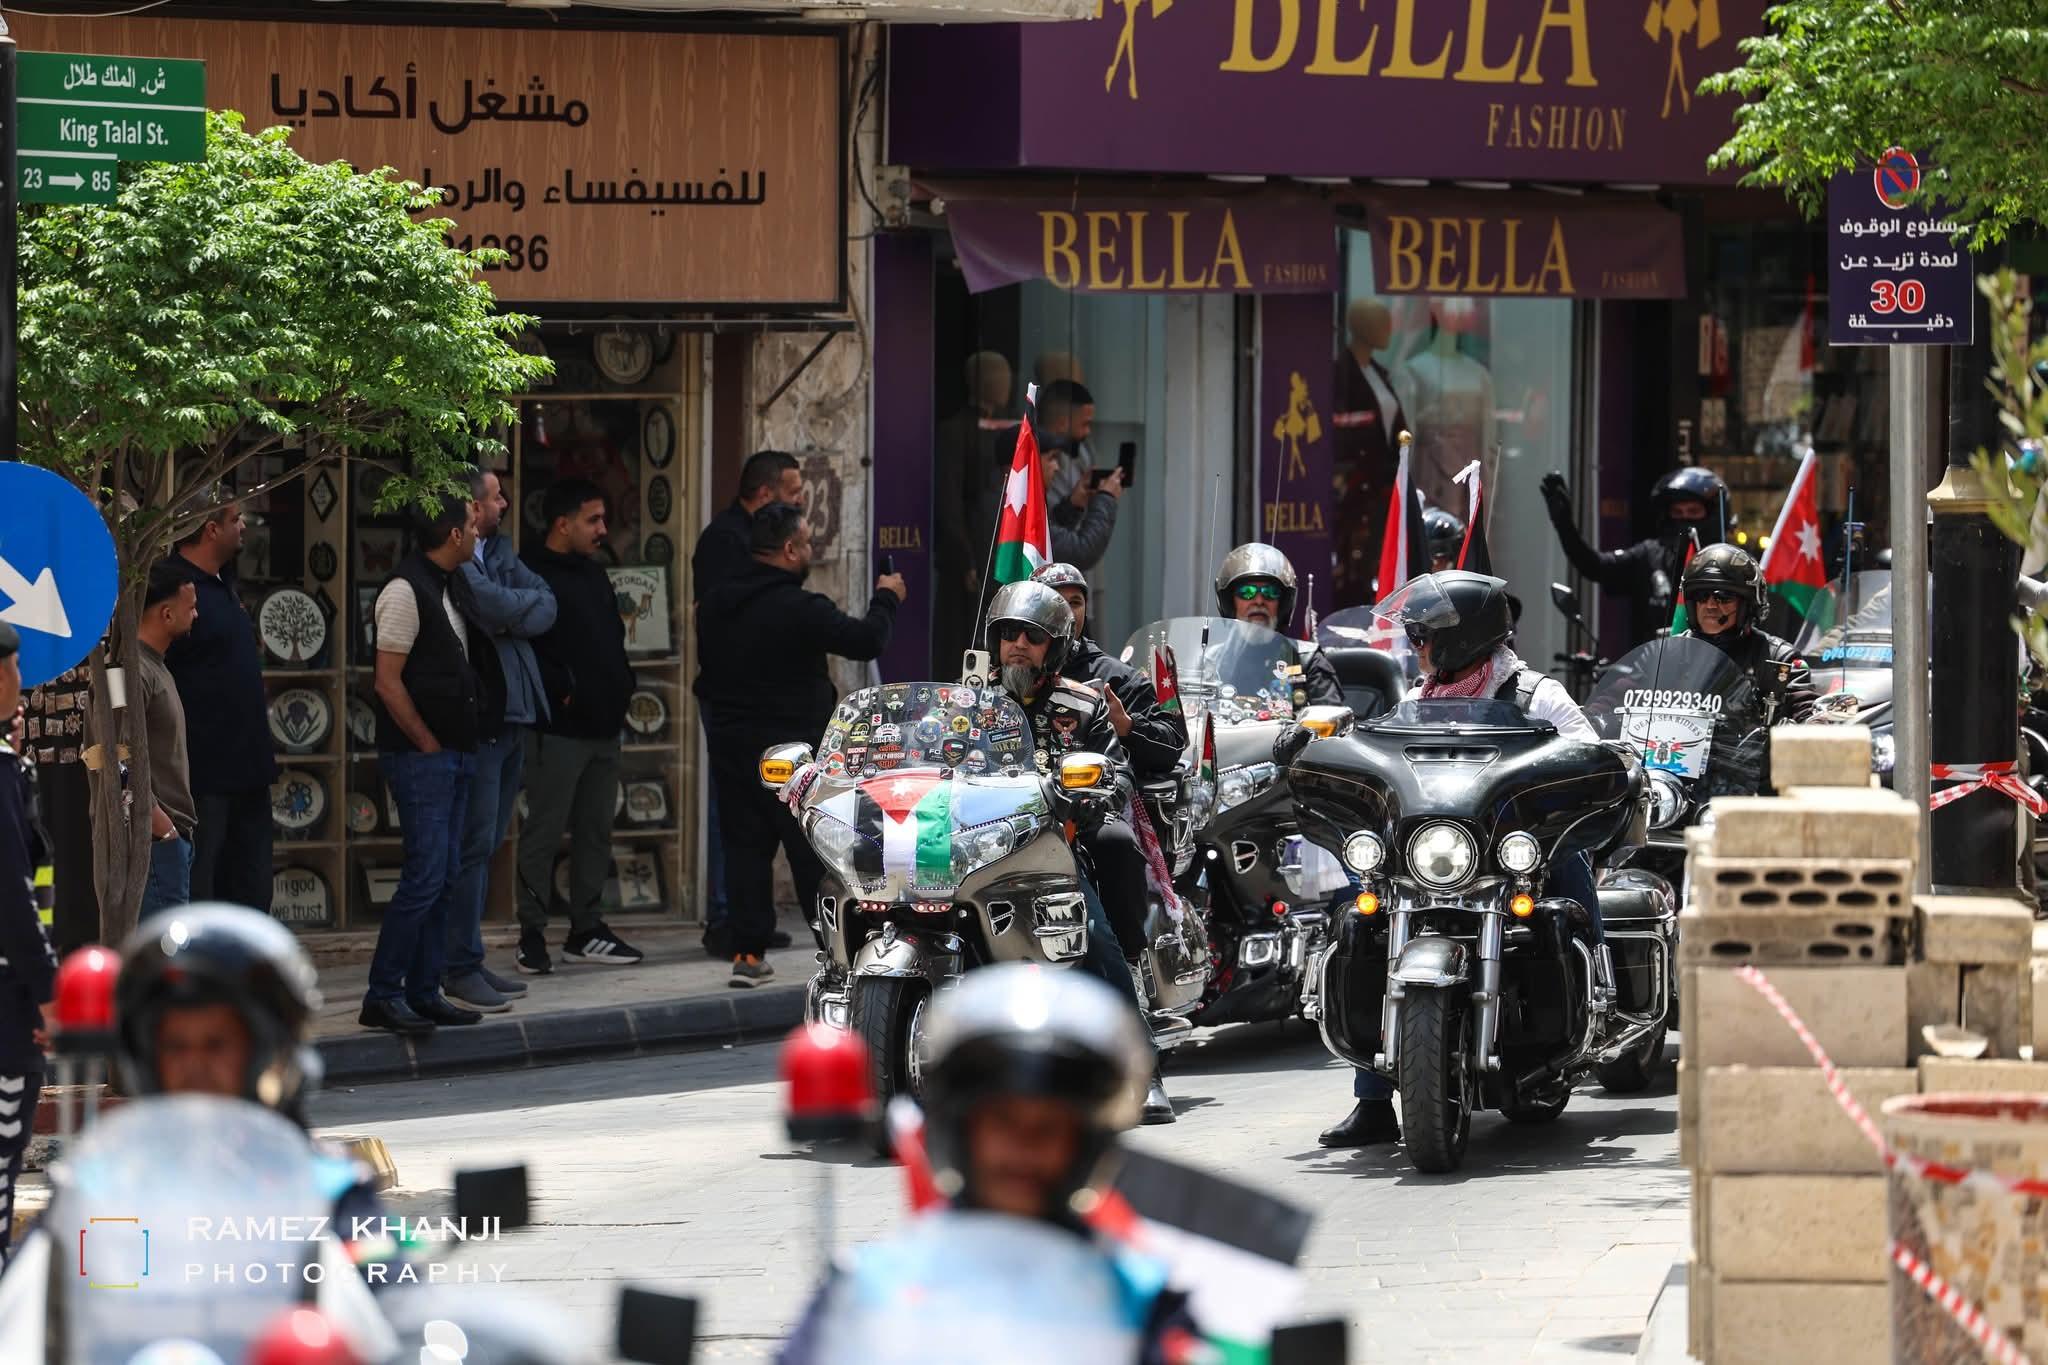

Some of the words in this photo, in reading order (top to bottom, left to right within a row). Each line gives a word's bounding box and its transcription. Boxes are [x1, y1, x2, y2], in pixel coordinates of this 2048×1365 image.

[63, 62, 97, 90] طلال
[101, 63, 136, 89] الملك
[140, 66, 166, 96] ش.
[271, 61, 417, 127] أكاديا
[429, 75, 589, 135] مشغل
[60, 117, 98, 148] King
[102, 119, 142, 145] Talal
[146, 122, 169, 146] St.
[1486, 103, 1626, 150] FASHION
[23, 167, 43, 189] 23
[91, 170, 111, 192] 85
[544, 166, 767, 216] للفسيفساء
[1839, 217, 1900, 238] الوقوف
[1037, 208, 1253, 290] BELLA
[1263, 263, 1327, 285] FASHION
[1386, 215, 1576, 295] BELLA
[1872, 251, 1914, 272] تزيد
[1920, 251, 1958, 268] لمدة
[1840, 253, 1868, 271] عن
[1870, 279, 1926, 315] 30
[1848, 313, 1954, 331] دقيقة
[1265, 501, 1325, 533] BELLA
[879, 526, 920, 549] BELLA
[1623, 689, 1722, 714] 0799929340
[1675, 715, 1702, 737] RIDERS
[275, 876, 289, 894] In
[291, 875, 316, 898] god
[271, 905, 290, 921] we
[292, 902, 323, 921] trust
